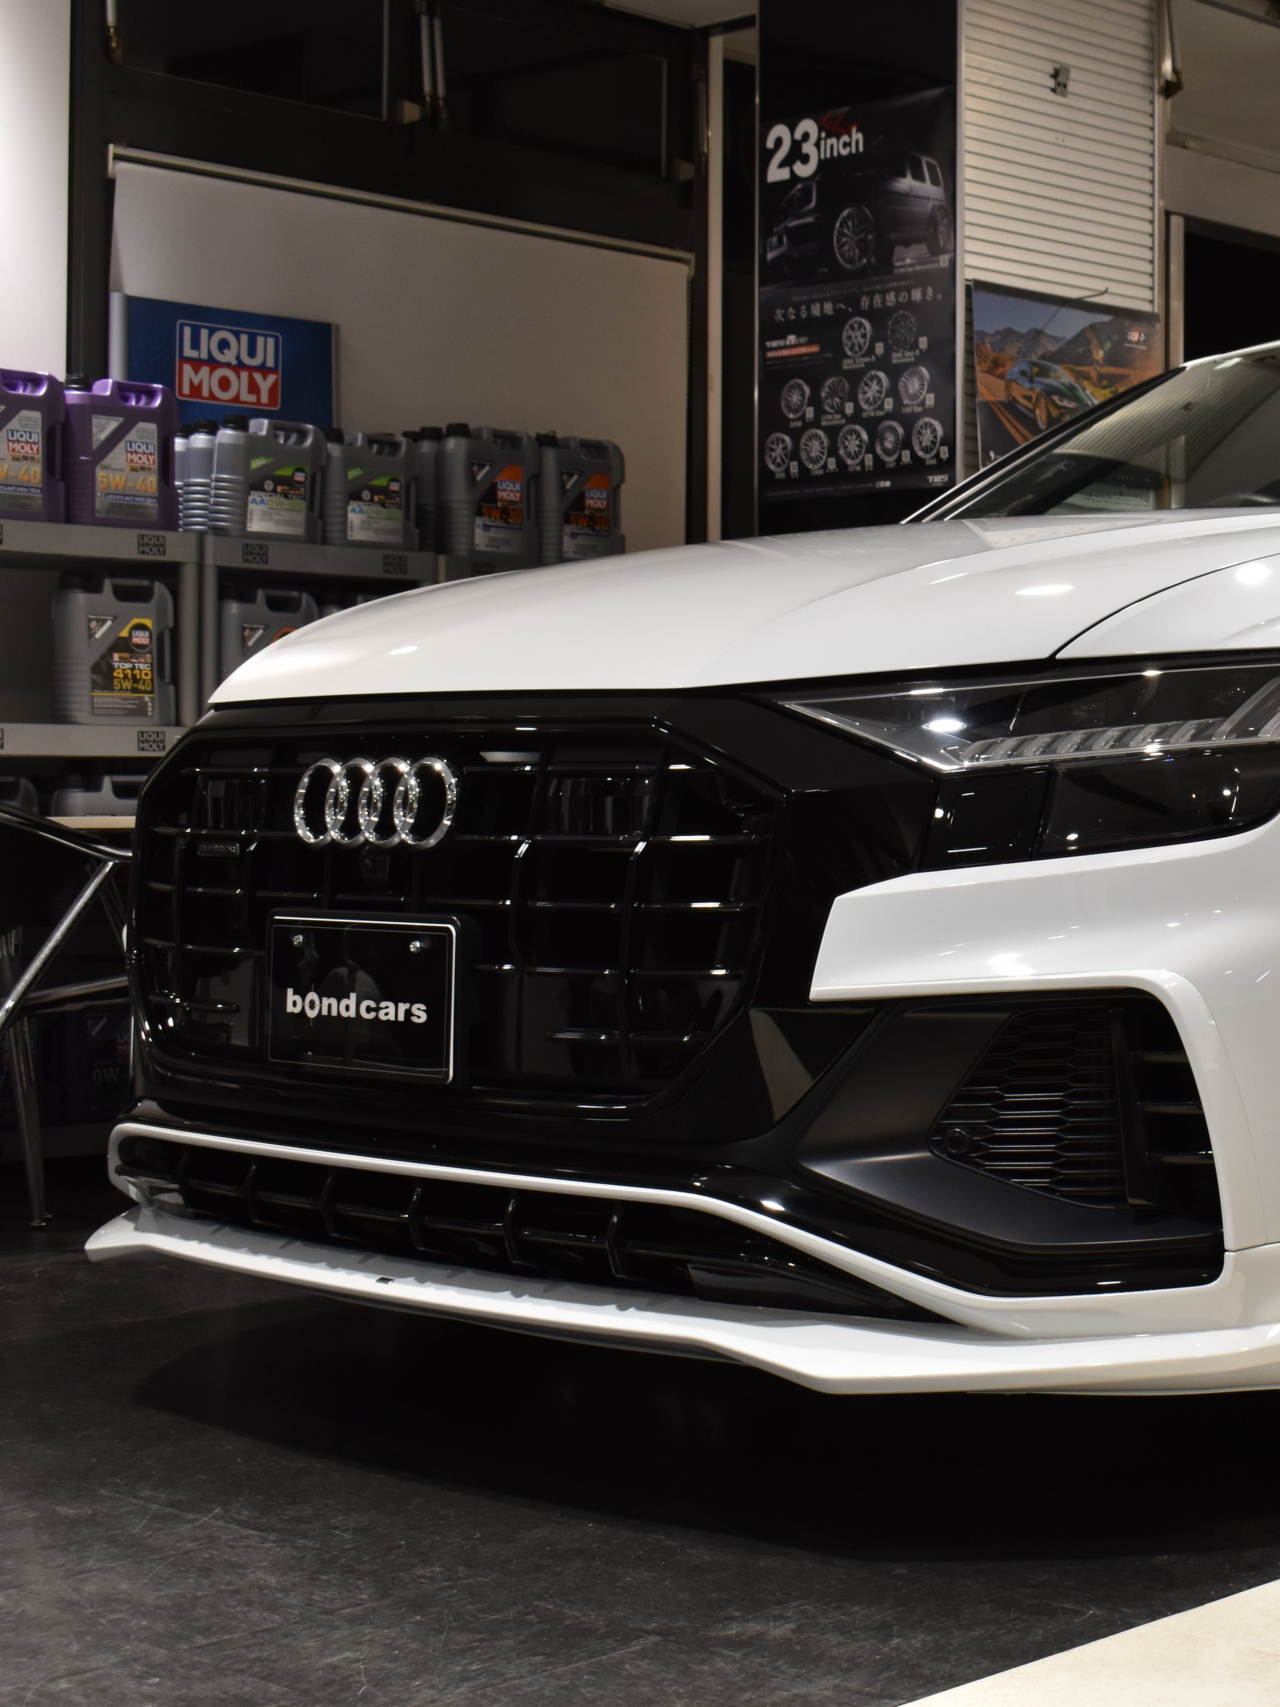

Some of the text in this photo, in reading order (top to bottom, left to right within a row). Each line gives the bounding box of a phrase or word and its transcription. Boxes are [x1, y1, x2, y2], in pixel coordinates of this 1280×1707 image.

[183, 325, 276, 368] LIQUI
[183, 367, 278, 408] MOLY
[8, 430, 39, 443] LIQUI
[8, 442, 40, 455] MOLY
[126, 441, 155, 454] LIQUI
[126, 453, 156, 465] MOLY
[0, 464, 41, 484] W-40
[97, 472, 157, 494] 5W-40
[497, 480, 522, 491] LIQUI
[497, 490, 522, 501] MOLY
[585, 488, 608, 499] LIQUI
[585, 498, 609, 508] MOLY
[481, 506, 523, 523] 5W-30
[570, 513, 609, 530] 5W-30
[139, 535, 165, 546] LIQUI
[139, 545, 166, 556] MOLY
[243, 545, 268, 555] LIQUI
[243, 554, 269, 565] MOLY
[113, 669, 152, 680] 4110
[113, 679, 152, 691] 5W-40
[138, 731, 165, 741] LIQUI
[138, 740, 165, 751] MOLY
